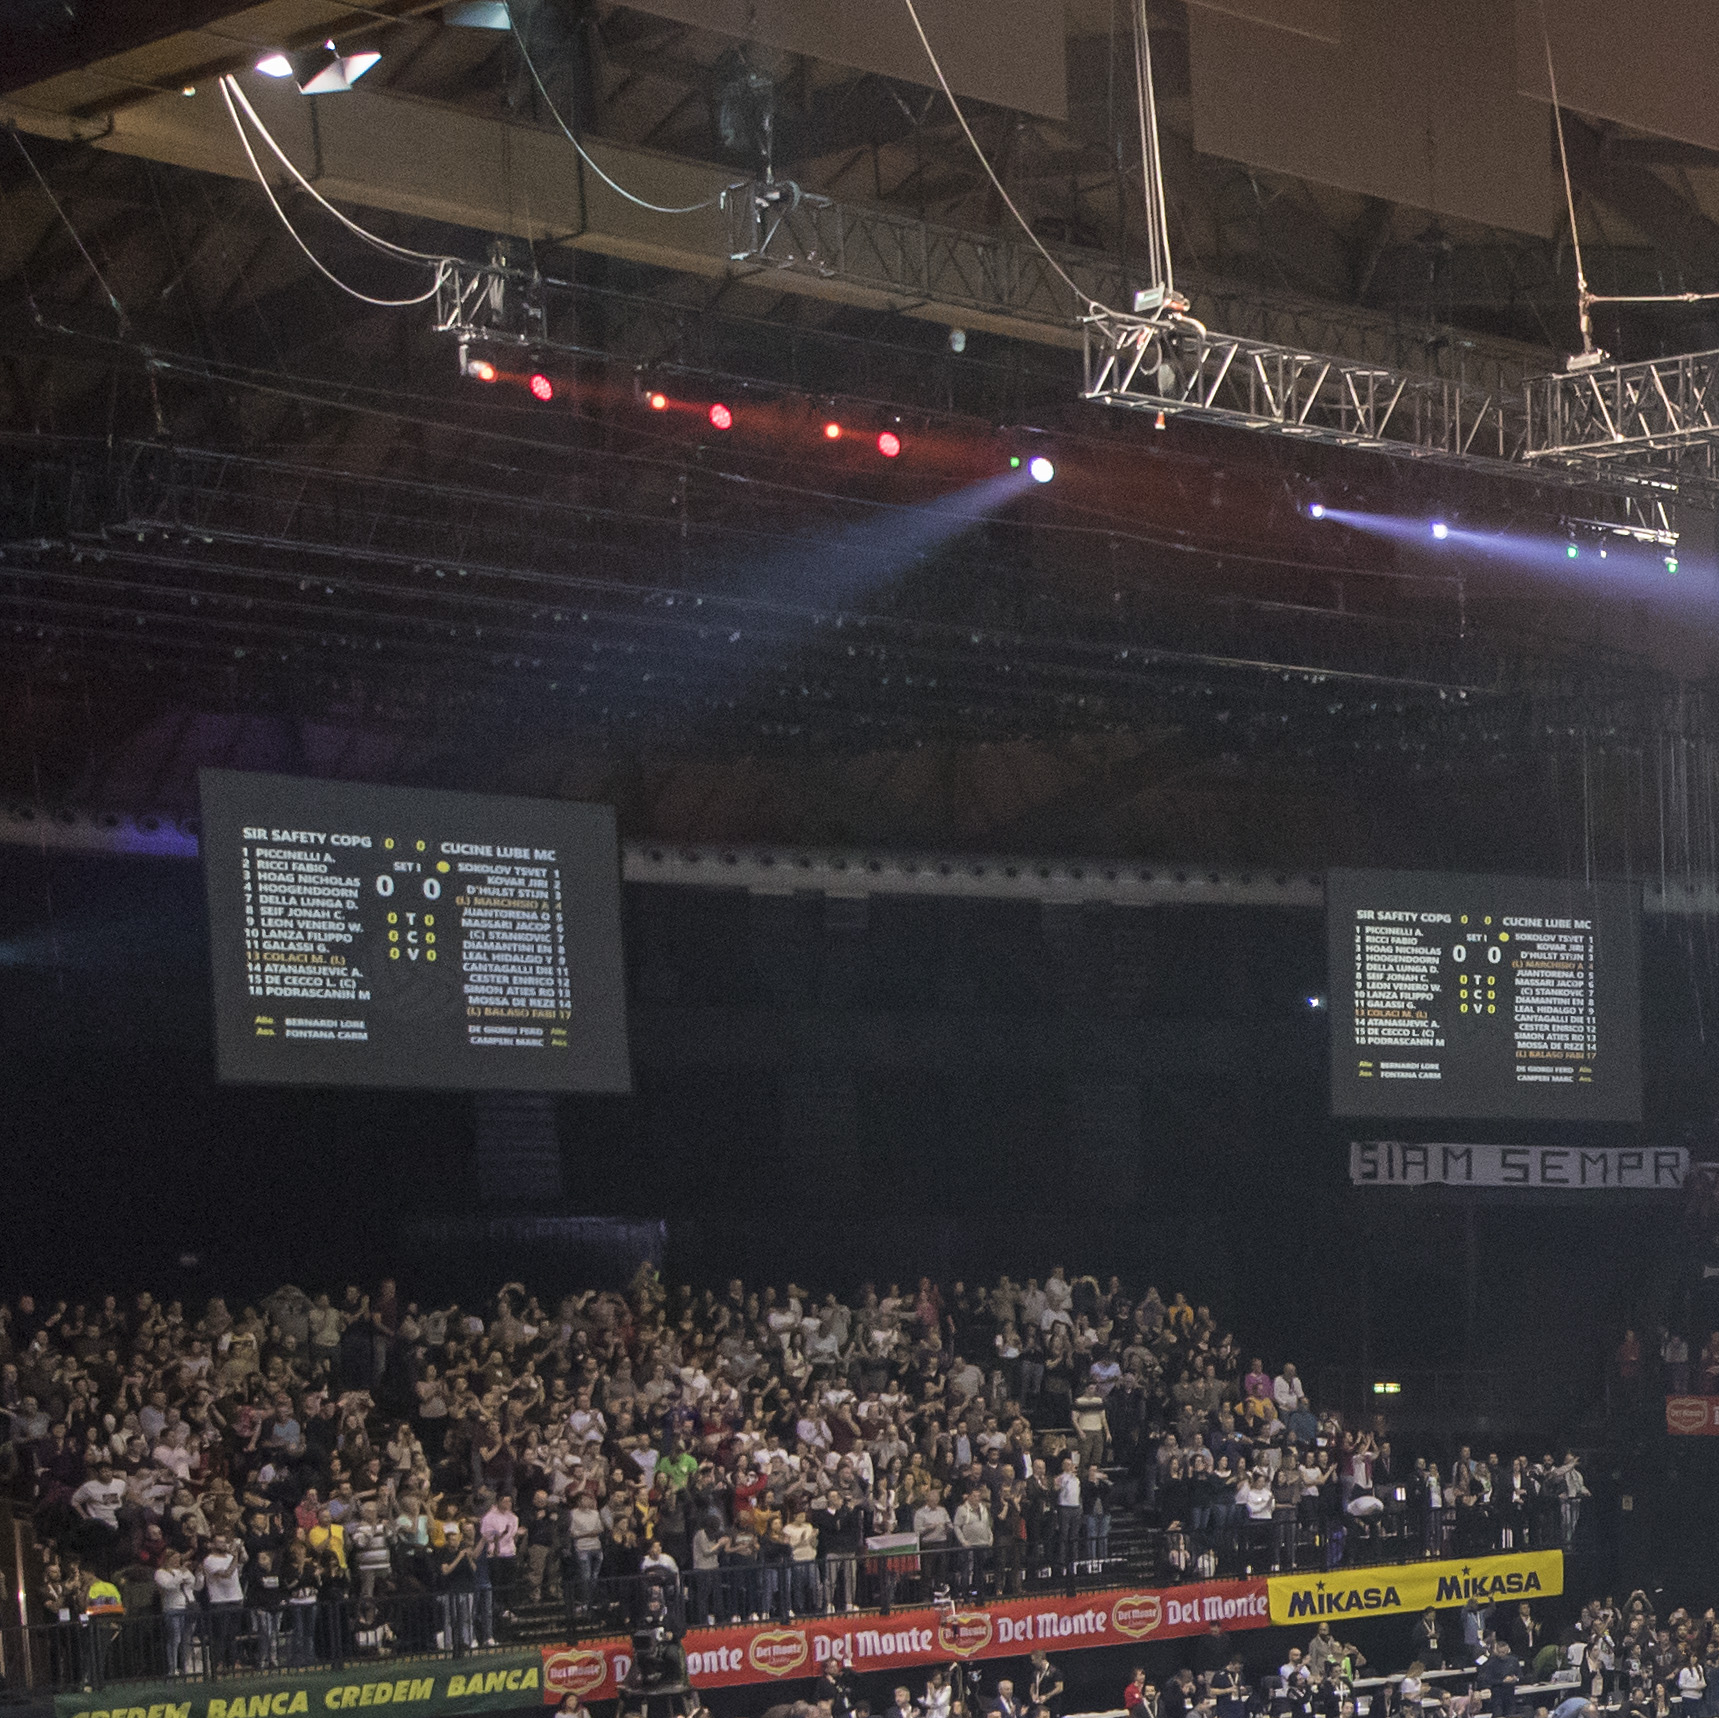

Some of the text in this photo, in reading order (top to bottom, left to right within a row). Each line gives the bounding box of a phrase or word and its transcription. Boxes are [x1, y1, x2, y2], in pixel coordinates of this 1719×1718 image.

[243, 827, 372, 848] SIR SAFETY COPG
[243, 847, 336, 863] 1 PICCINELLI A.
[441, 842, 556, 862] CUCINE LUBE MC
[243, 858, 328, 874] 2 RICCI FABIO
[393, 862, 415, 872] SET
[258, 871, 360, 887] HOAG NICHOLAS
[259, 883, 358, 899] HOOGENDOORN
[376, 875, 394, 897] 0
[423, 878, 441, 900] 0
[245, 894, 358, 910] 7 DELLA LUNGA D.
[406, 912, 416, 925] T
[1357, 910, 1451, 924] SIR SAFETY COPG
[1503, 917, 1592, 930] CUCINE LUBE MC
[261, 918, 363, 933] LEON VENERO W.
[1365, 926, 1413, 936] PICCINELLI
[245, 928, 352, 943] 10 LANZA FILIPPO
[407, 931, 418, 944] C
[1366, 936, 1389, 944] RICCI
[1466, 934, 1482, 942] SET
[1515, 933, 1556, 942] SOKOLOV
[246, 940, 313, 952] 11 GALASSI
[1395, 946, 1441, 956] NICHOLAS
[1537, 943, 1566, 952] KOVAR
[263, 952, 307, 962] COLACI
[408, 948, 419, 960] V
[1453, 945, 1467, 962] 0
[1488, 946, 1501, 963] 0
[248, 962, 363, 977] 14 ATANASIJEVIC A.
[1366, 963, 1428, 973] DELLA LUNGA
[1517, 969, 1574, 978] JUANTORENA
[248, 974, 356, 989] 15 DE CECCO (C)
[1515, 978, 1584, 988] MASSARI JACOP
[266, 987, 370, 1000] PODRASCANIN M
[1367, 991, 1434, 1001] LANZA FILIPPO
[1521, 987, 1584, 997] (C) STANKOVIC
[1367, 1000, 1404, 1009] GALASSI
[1515, 1005, 1576, 1015] LEAL HIDALGO
[1515, 1014, 1568, 1023] CANTAGALLI
[1519, 1023, 1550, 1032] CESTER
[1368, 1037, 1433, 1047] PODRASCANIN
[1514, 1032, 1544, 1041] SIMON
[1517, 1041, 1548, 1050] MOSSA
[1361, 1146, 1473, 1182] SIAM
[1436, 1570, 1541, 1602] MIKASA
[1288, 1585, 1402, 1618] MIKASA
[1167, 1592, 1267, 1625] Del Monte
[998, 1616, 1034, 1643] Del
[1037, 1611, 1107, 1639] Monte
[814, 1632, 853, 1662] Del
[857, 1627, 932, 1656] Monte
[447, 1667, 539, 1698] BANCA
[324, 1677, 435, 1710] CREDEM
